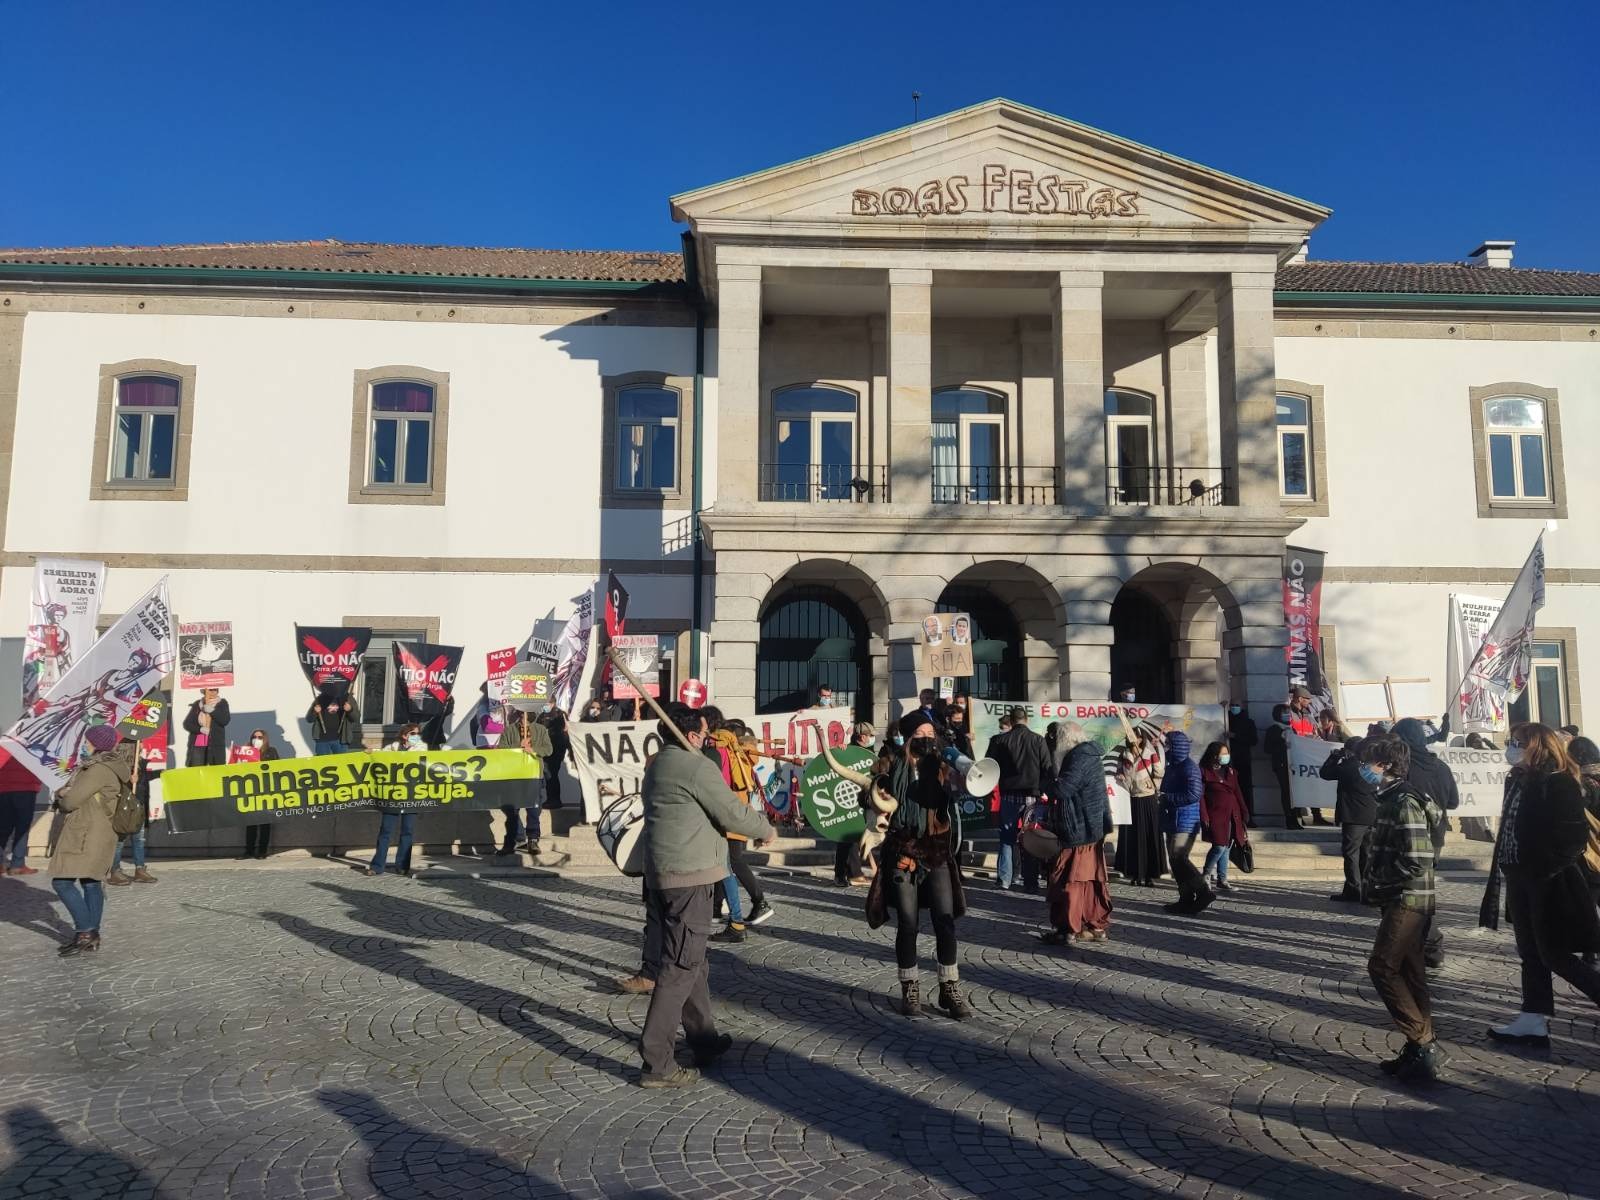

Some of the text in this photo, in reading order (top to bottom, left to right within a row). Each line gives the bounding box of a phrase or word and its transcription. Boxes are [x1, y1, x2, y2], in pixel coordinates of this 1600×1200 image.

[1287, 558, 1307, 686] MINAS NÃO
[490, 650, 513, 661] NÃO
[532, 639, 558, 657] MINAS
[300, 650, 336, 666] LÍTIO
[399, 665, 455, 684] ÍTIO NÃO
[489, 670, 509, 680] MIN
[983, 703, 1035, 718] VERE
[1041, 703, 1051, 718] É
[1057, 705, 1070, 719] O
[584, 725, 664, 764] NÃO
[222, 755, 487, 797] minas verdes?
[237, 777, 475, 813] uma mentira suja.
[275, 810, 283, 818] O
[285, 807, 304, 816] LÍTIO
[306, 805, 324, 814] NÃO
[334, 798, 376, 811] RENOVÁVEL
[389, 799, 438, 809] SUSTENTÁVEL
[819, 815, 847, 829] Terras
[846, 810, 859, 820] do
